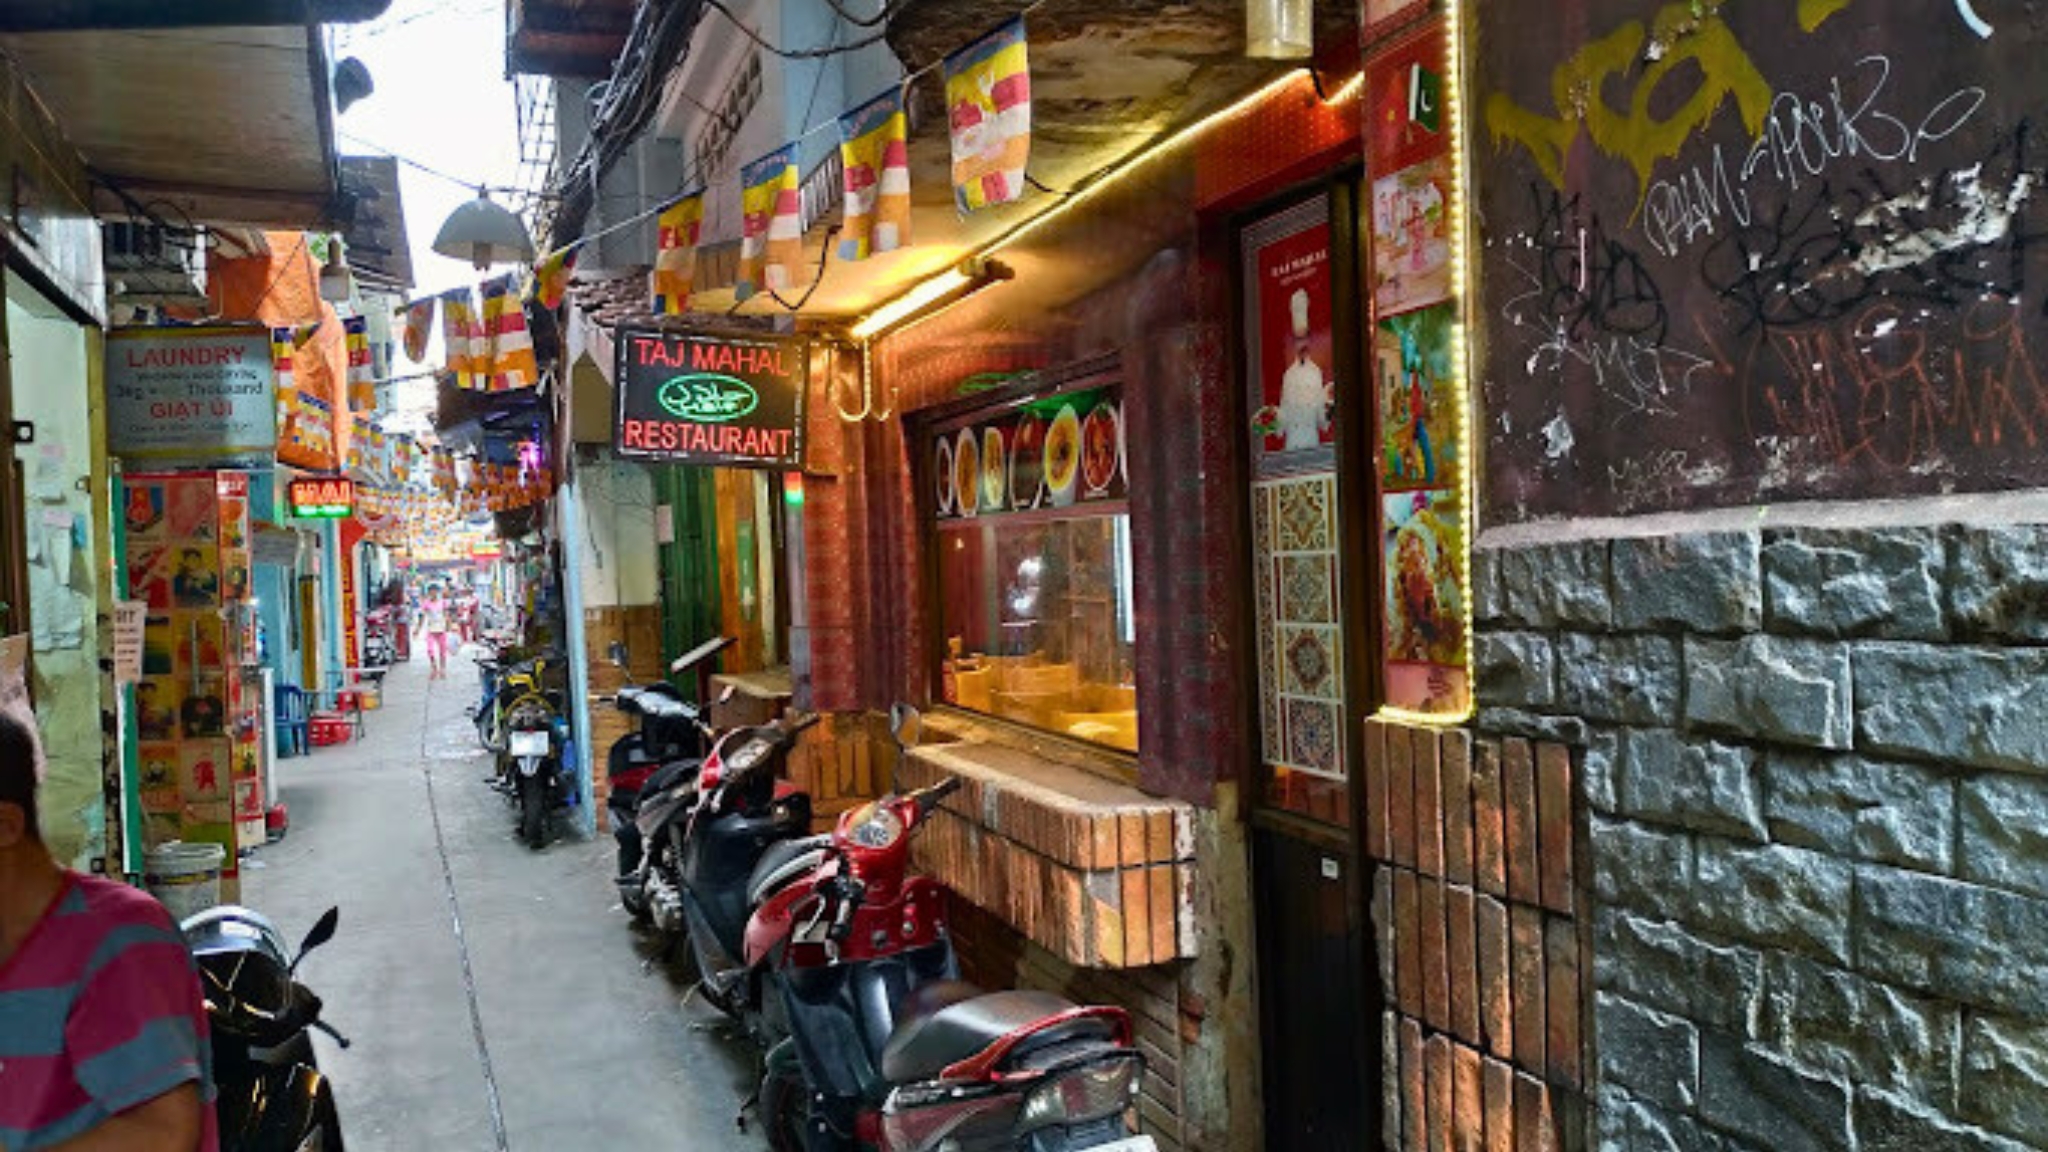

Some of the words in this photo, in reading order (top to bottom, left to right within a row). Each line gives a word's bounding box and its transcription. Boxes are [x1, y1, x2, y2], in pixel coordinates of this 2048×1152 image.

[127, 345, 246, 368] LAUNDRY
[634, 338, 685, 368] TAJ
[692, 344, 791, 377] MAHAL
[187, 382, 263, 396] Thousand
[624, 419, 793, 456] RESTAURANT
